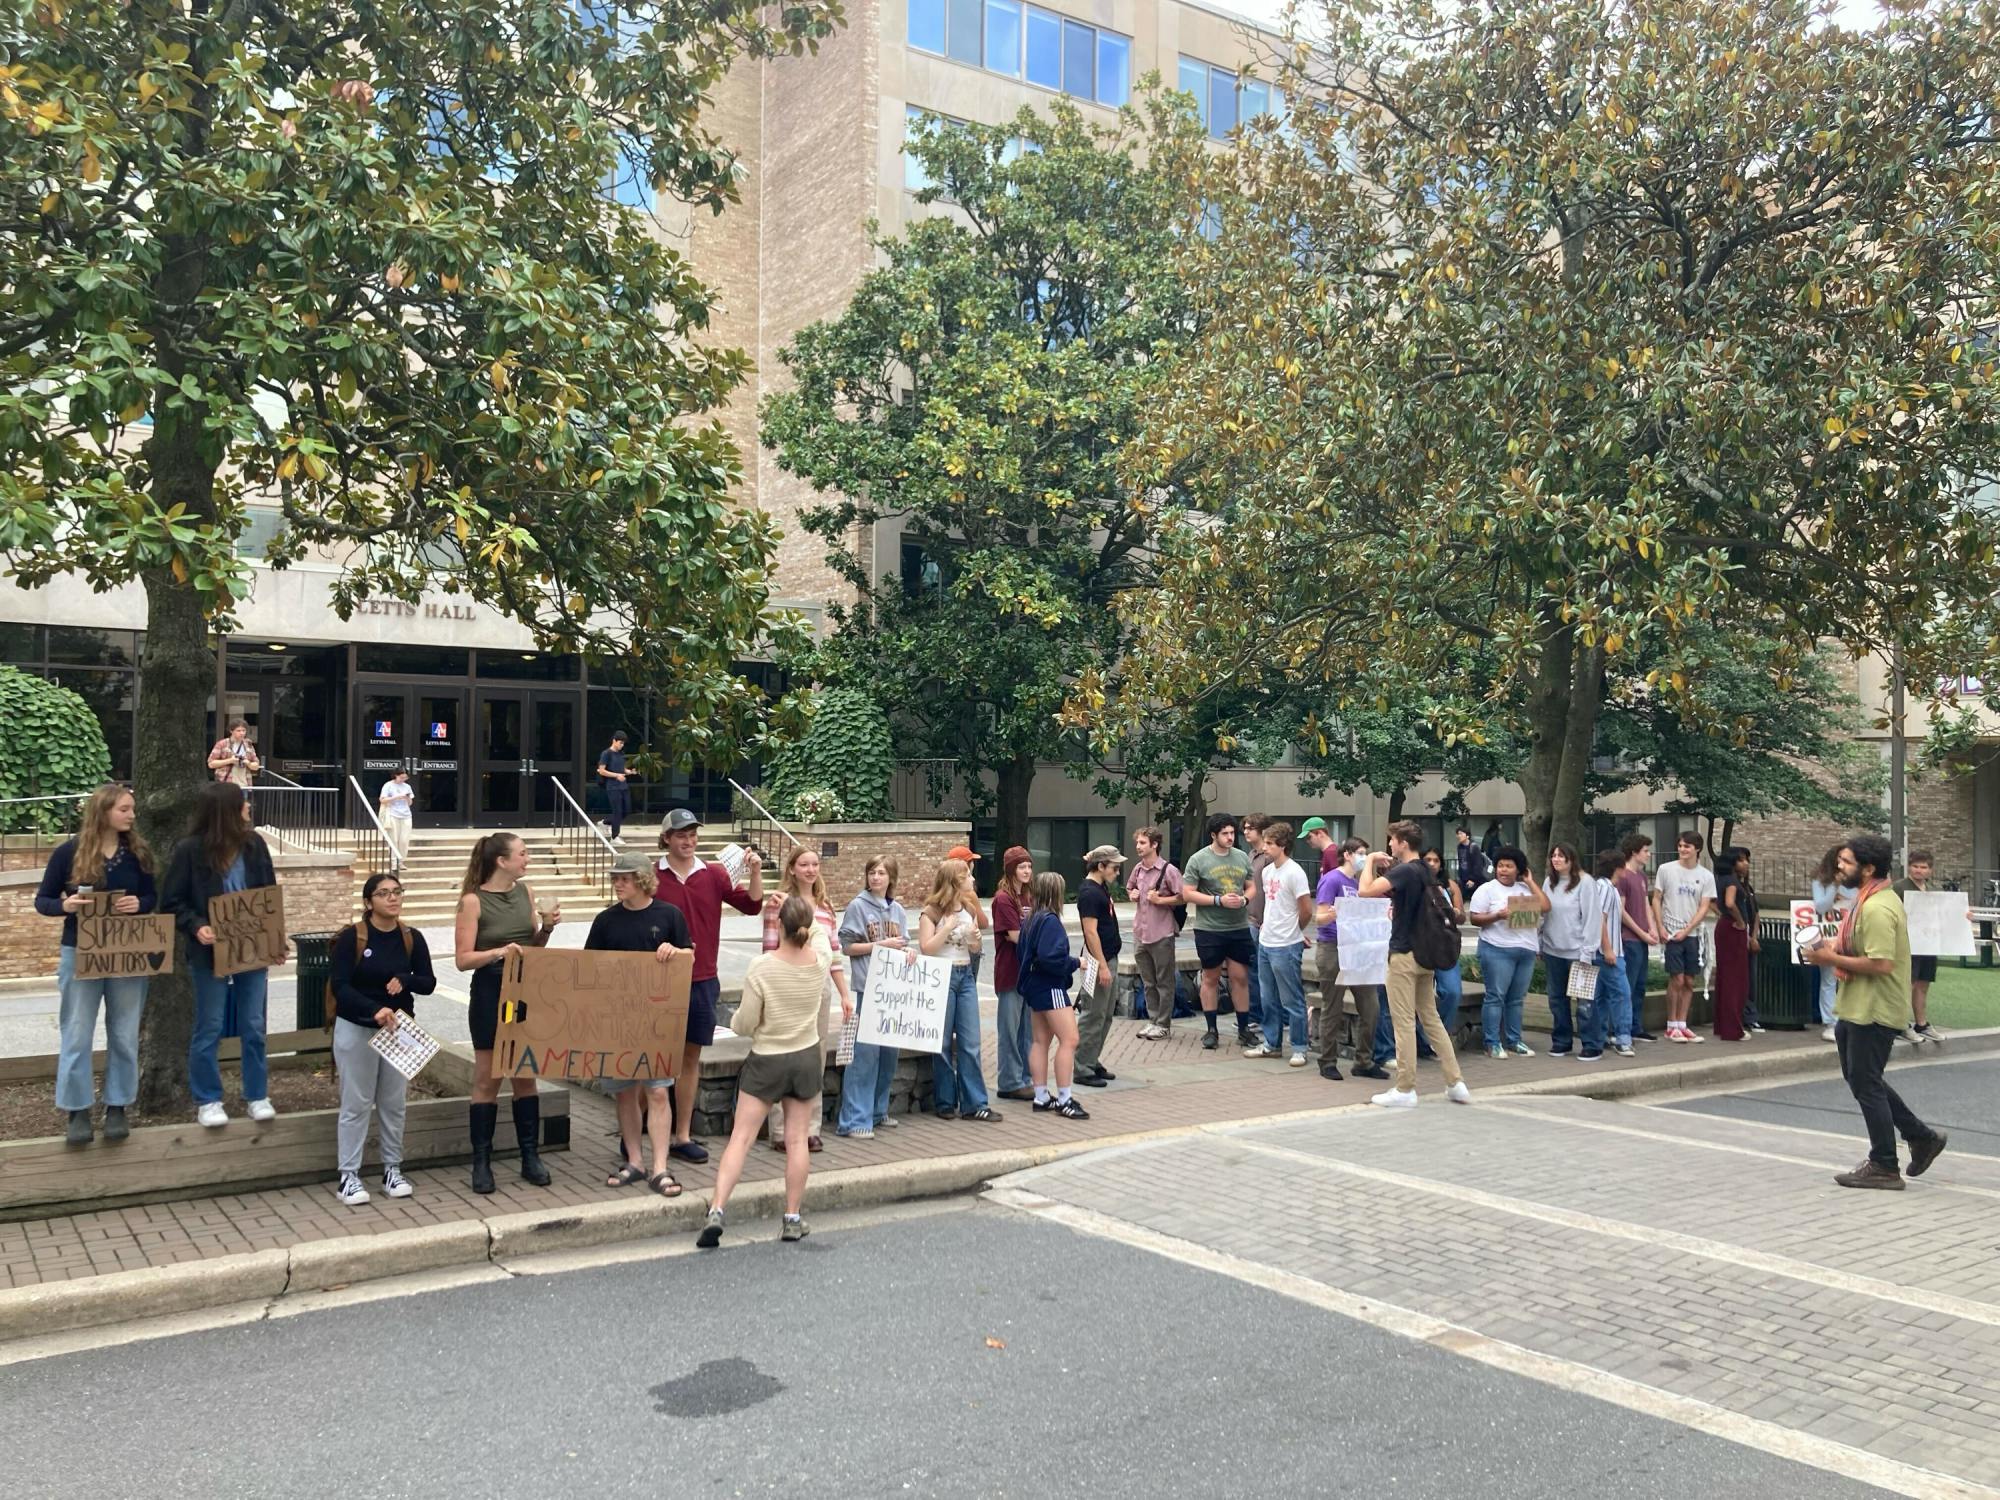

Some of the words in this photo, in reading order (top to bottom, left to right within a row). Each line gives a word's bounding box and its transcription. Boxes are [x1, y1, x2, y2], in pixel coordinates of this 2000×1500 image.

[357, 600, 416, 617] LETTS
[425, 603, 476, 621] HALL
[82, 892, 126, 918] WE
[212, 887, 277, 924] WAGE
[78, 917, 147, 951] SUPPORT
[77, 951, 147, 975] JANITORS
[916, 991, 936, 1012] the
[514, 1045, 673, 1078] AMERICAN
